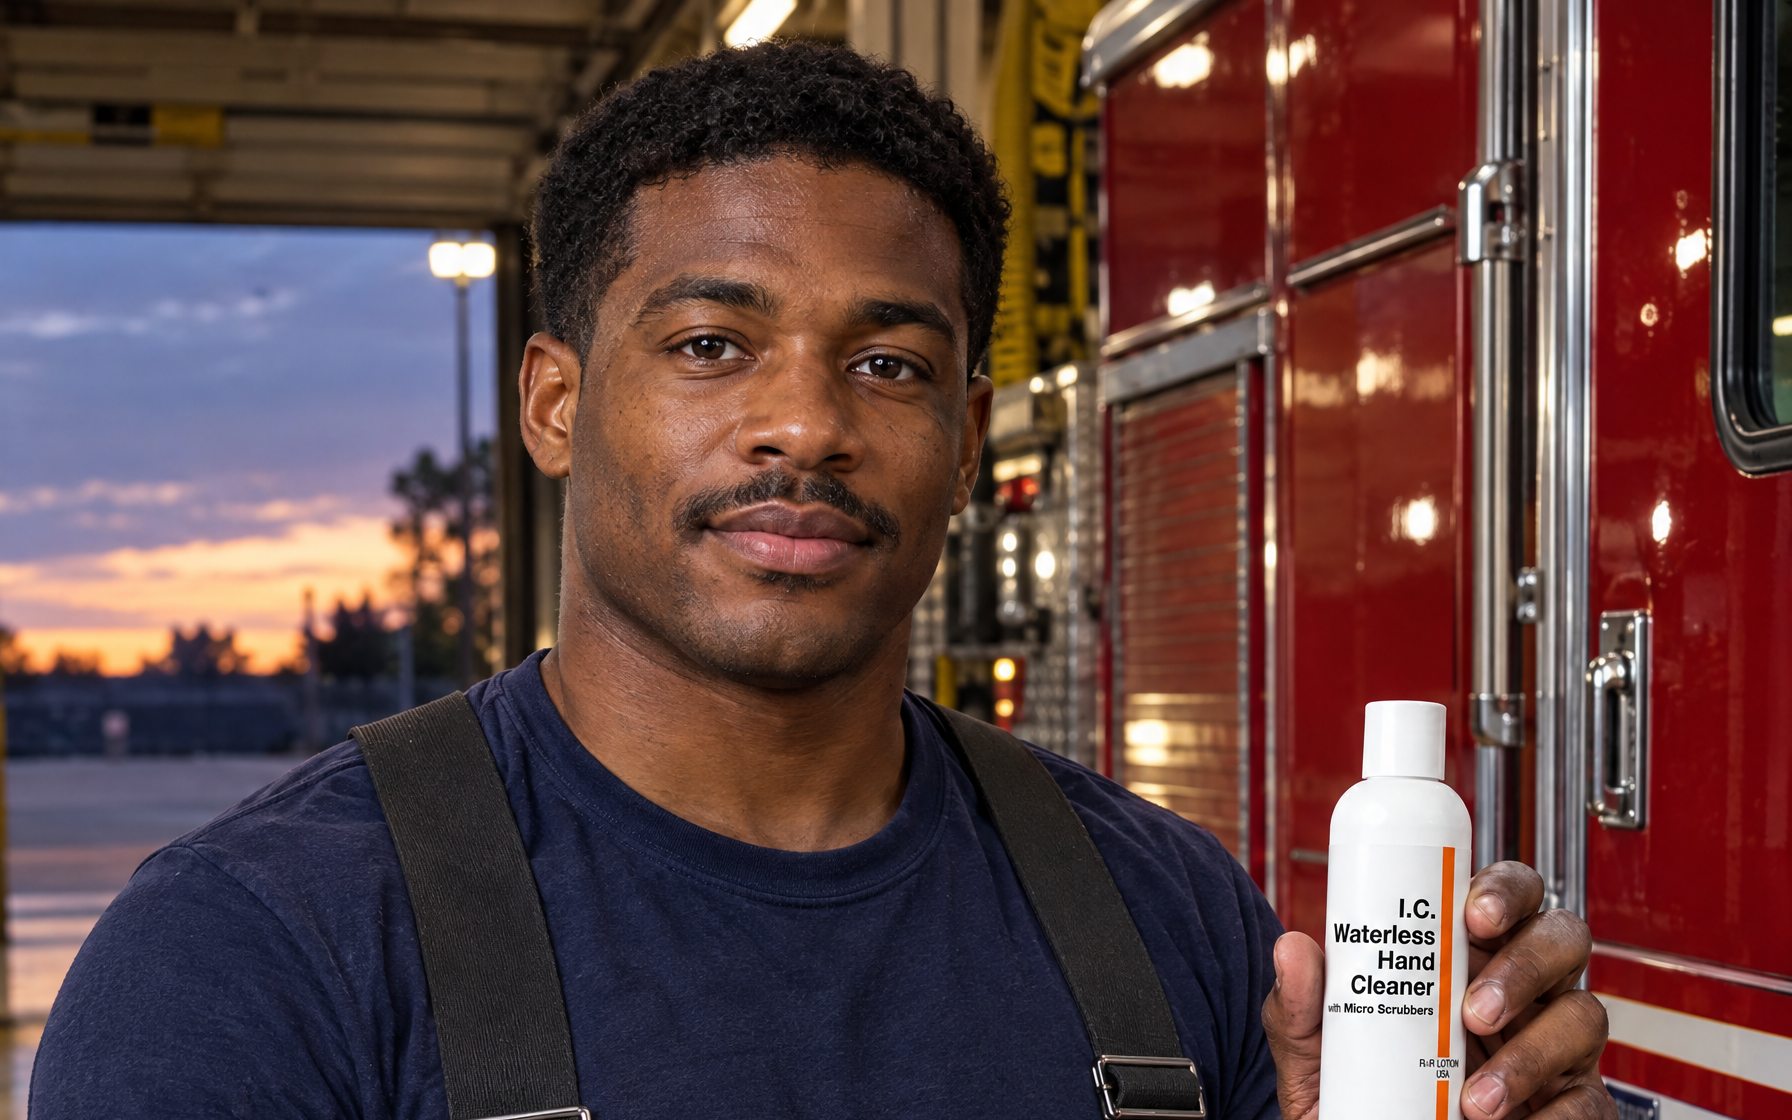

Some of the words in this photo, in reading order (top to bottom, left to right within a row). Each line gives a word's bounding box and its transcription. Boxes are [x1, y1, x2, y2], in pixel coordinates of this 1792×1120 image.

[1399, 898, 1436, 919] I.C.
[1334, 923, 1436, 945] Waterless
[1378, 950, 1435, 971] Hand
[1351, 975, 1435, 996] Cleaner
[1344, 1003, 1374, 1014] Micro
[1378, 1004, 1434, 1016] Scrubbers
[1436, 1059, 1459, 1068] LOTION
[1436, 1070, 1450, 1079] USA
